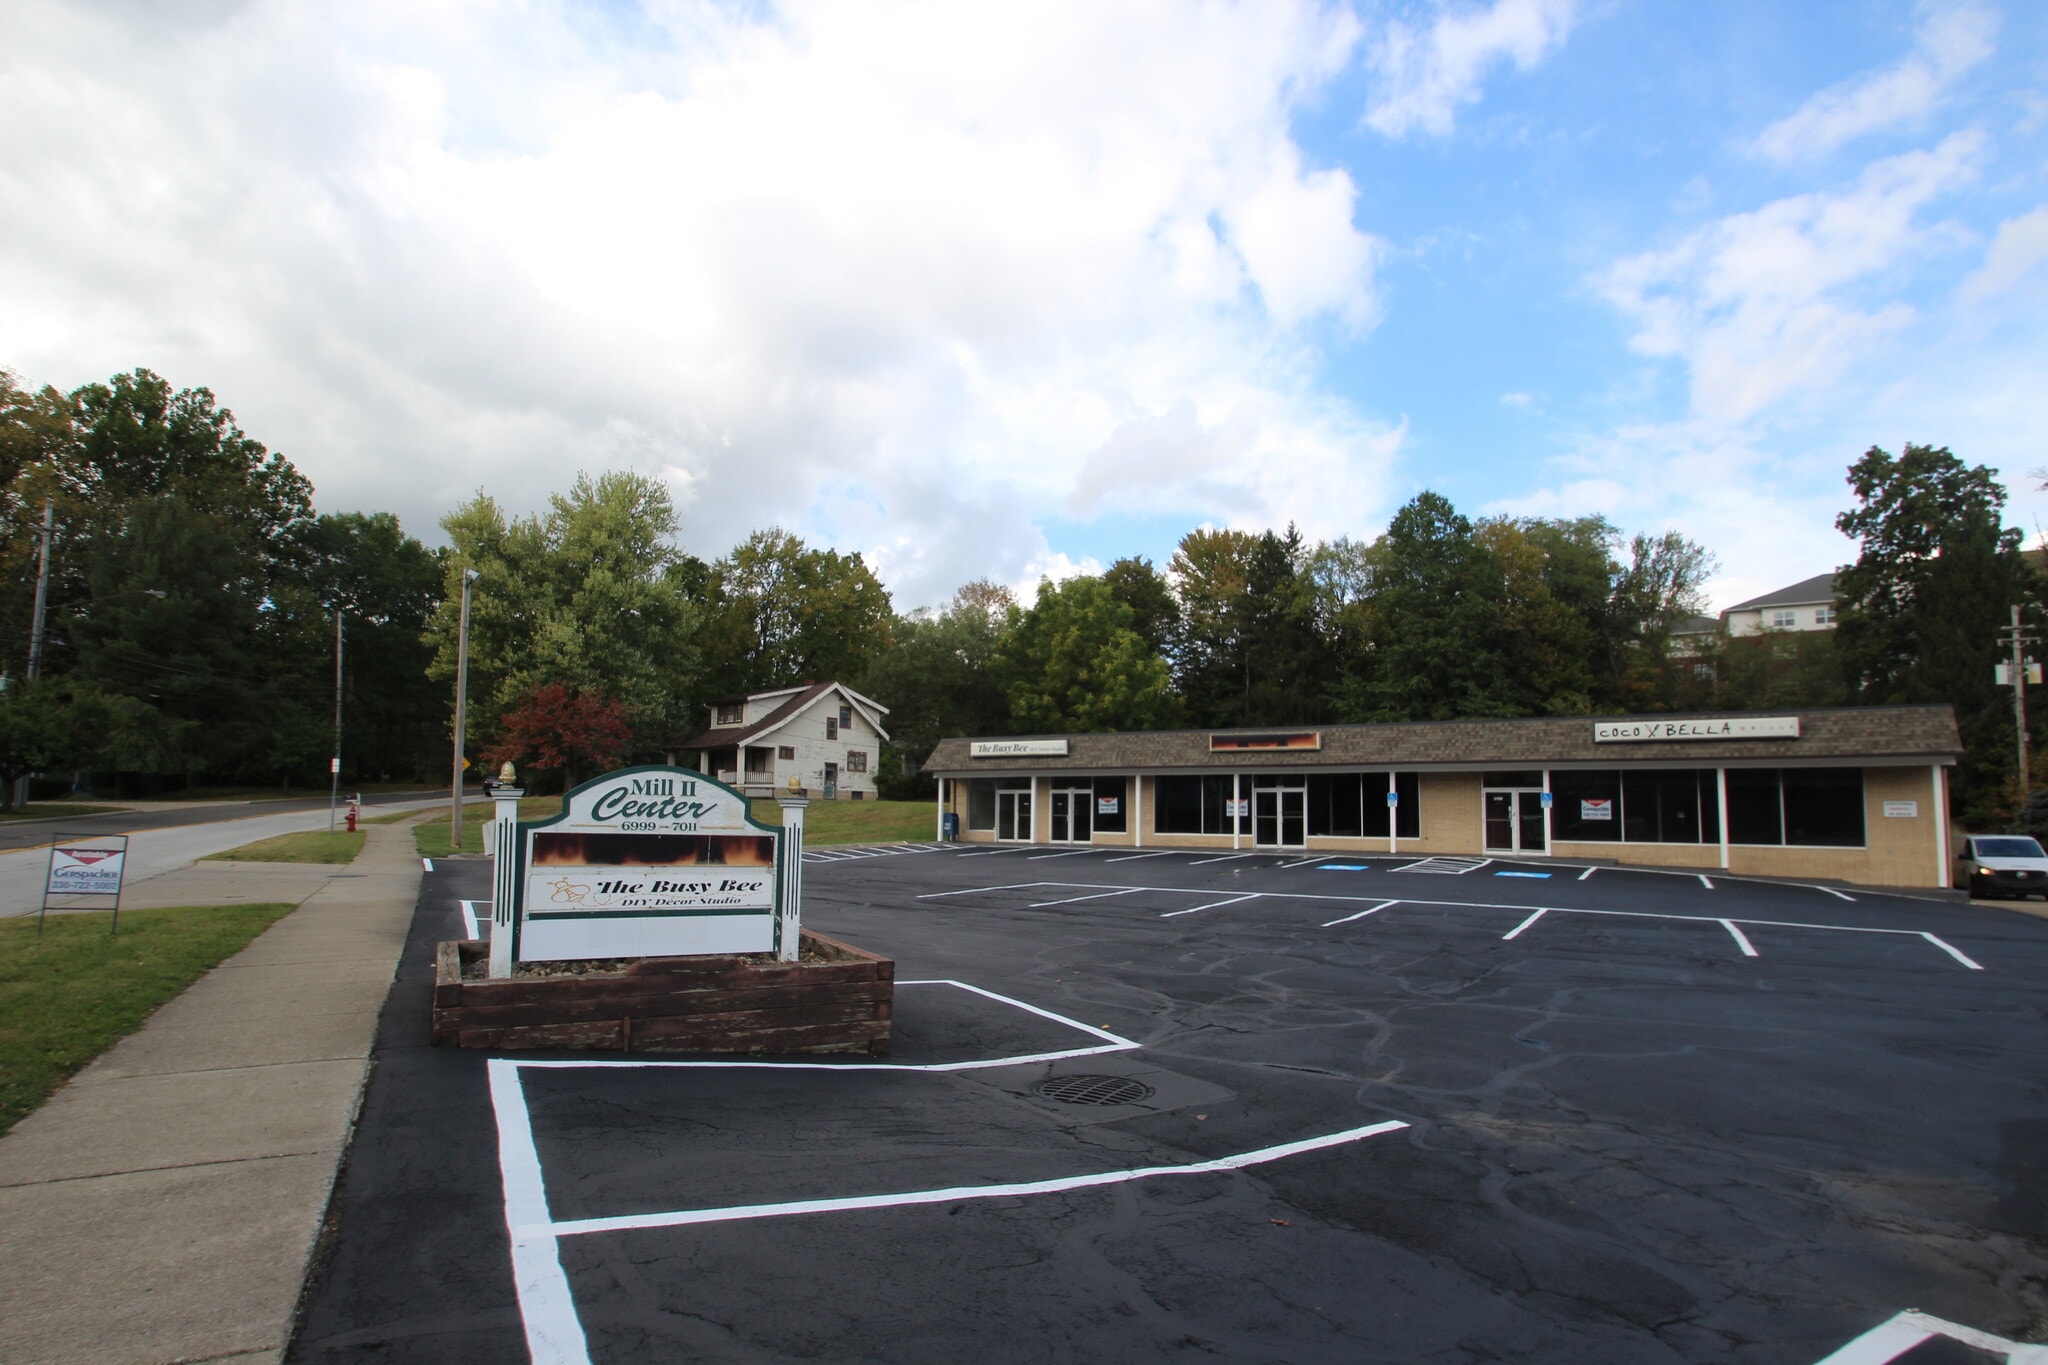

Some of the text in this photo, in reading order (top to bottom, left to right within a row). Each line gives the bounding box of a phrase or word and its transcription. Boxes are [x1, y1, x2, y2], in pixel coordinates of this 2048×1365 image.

[1600, 727, 1640, 737] COCO
[1665, 722, 1731, 736] BELLA
[977, 744, 992, 753] The
[1013, 743, 1028, 752] Bee
[630, 778, 697, 797] Mill II
[591, 786, 718, 822] Center
[621, 821, 656, 832] 6999
[672, 822, 697, 832] 7011
[597, 879, 763, 895] The Busy Bee
[700, 896, 741, 905] Studio
